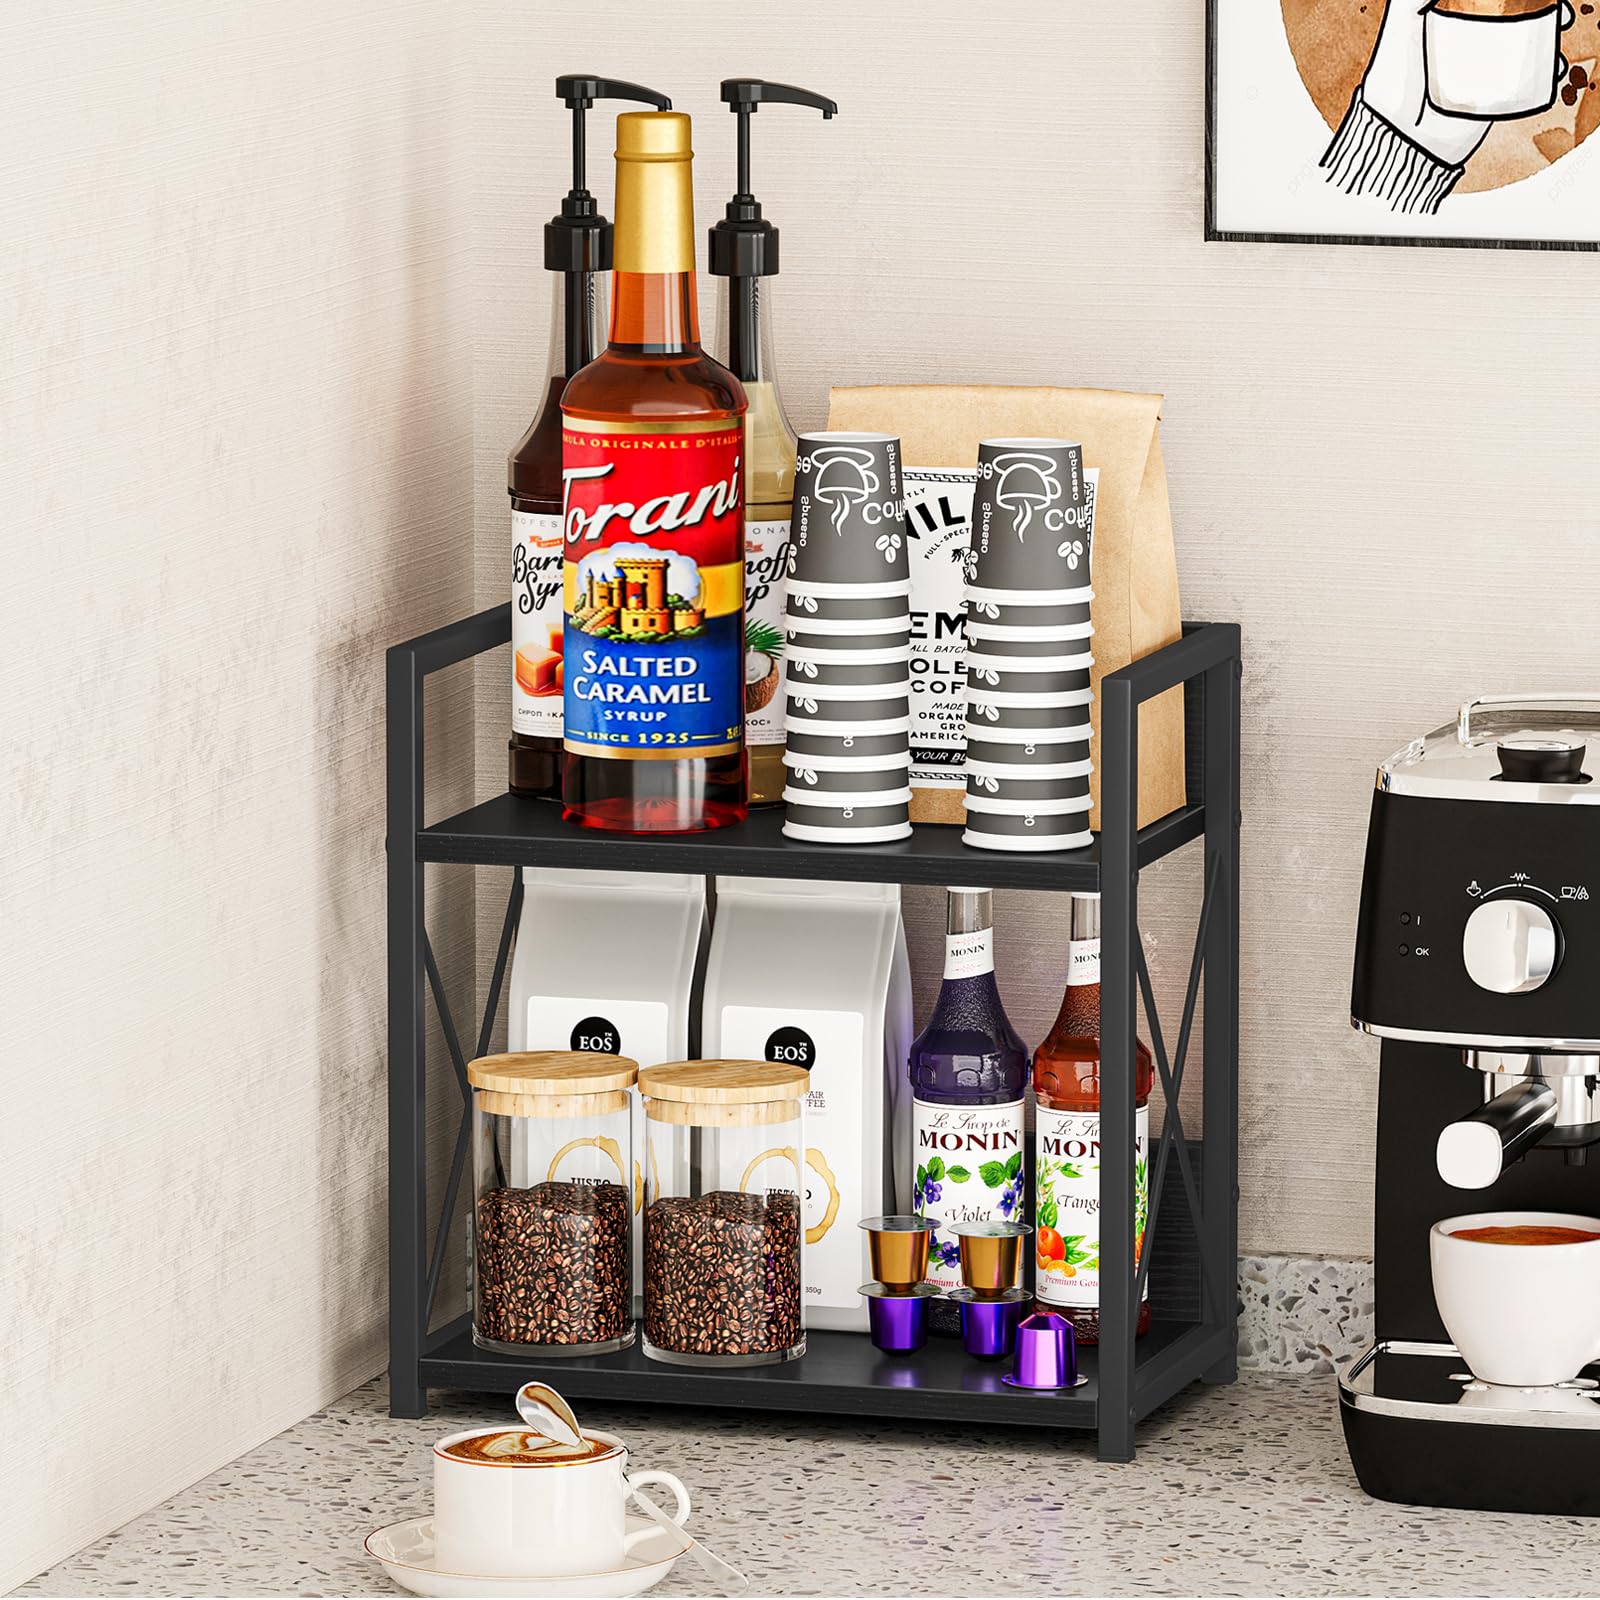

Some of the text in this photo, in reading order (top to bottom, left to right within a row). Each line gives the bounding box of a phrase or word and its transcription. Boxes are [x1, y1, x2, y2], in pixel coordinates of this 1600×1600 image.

[590, 438, 690, 449] ORIGINALE
[563, 456, 740, 543] Torani
[582, 650, 697, 677] SALTED
[572, 676, 711, 704] CARAMEL
[931, 702, 964, 711] MADE
[604, 710, 667, 722] SYRUP
[586, 732, 689, 744] SINCE 1925
[915, 751, 949, 760] YOUR
[950, 943, 985, 957] MONIN
[1415, 947, 1430, 957] OK
[578, 1036, 612, 1051] EOS
[773, 1045, 807, 1061] EOS
[928, 1112, 949, 1129] Le
[952, 1112, 993, 1134] Sirop
[1051, 1119, 1073, 1136] Le
[919, 1128, 1019, 1152] MONIN
[944, 1204, 991, 1222] Violet
